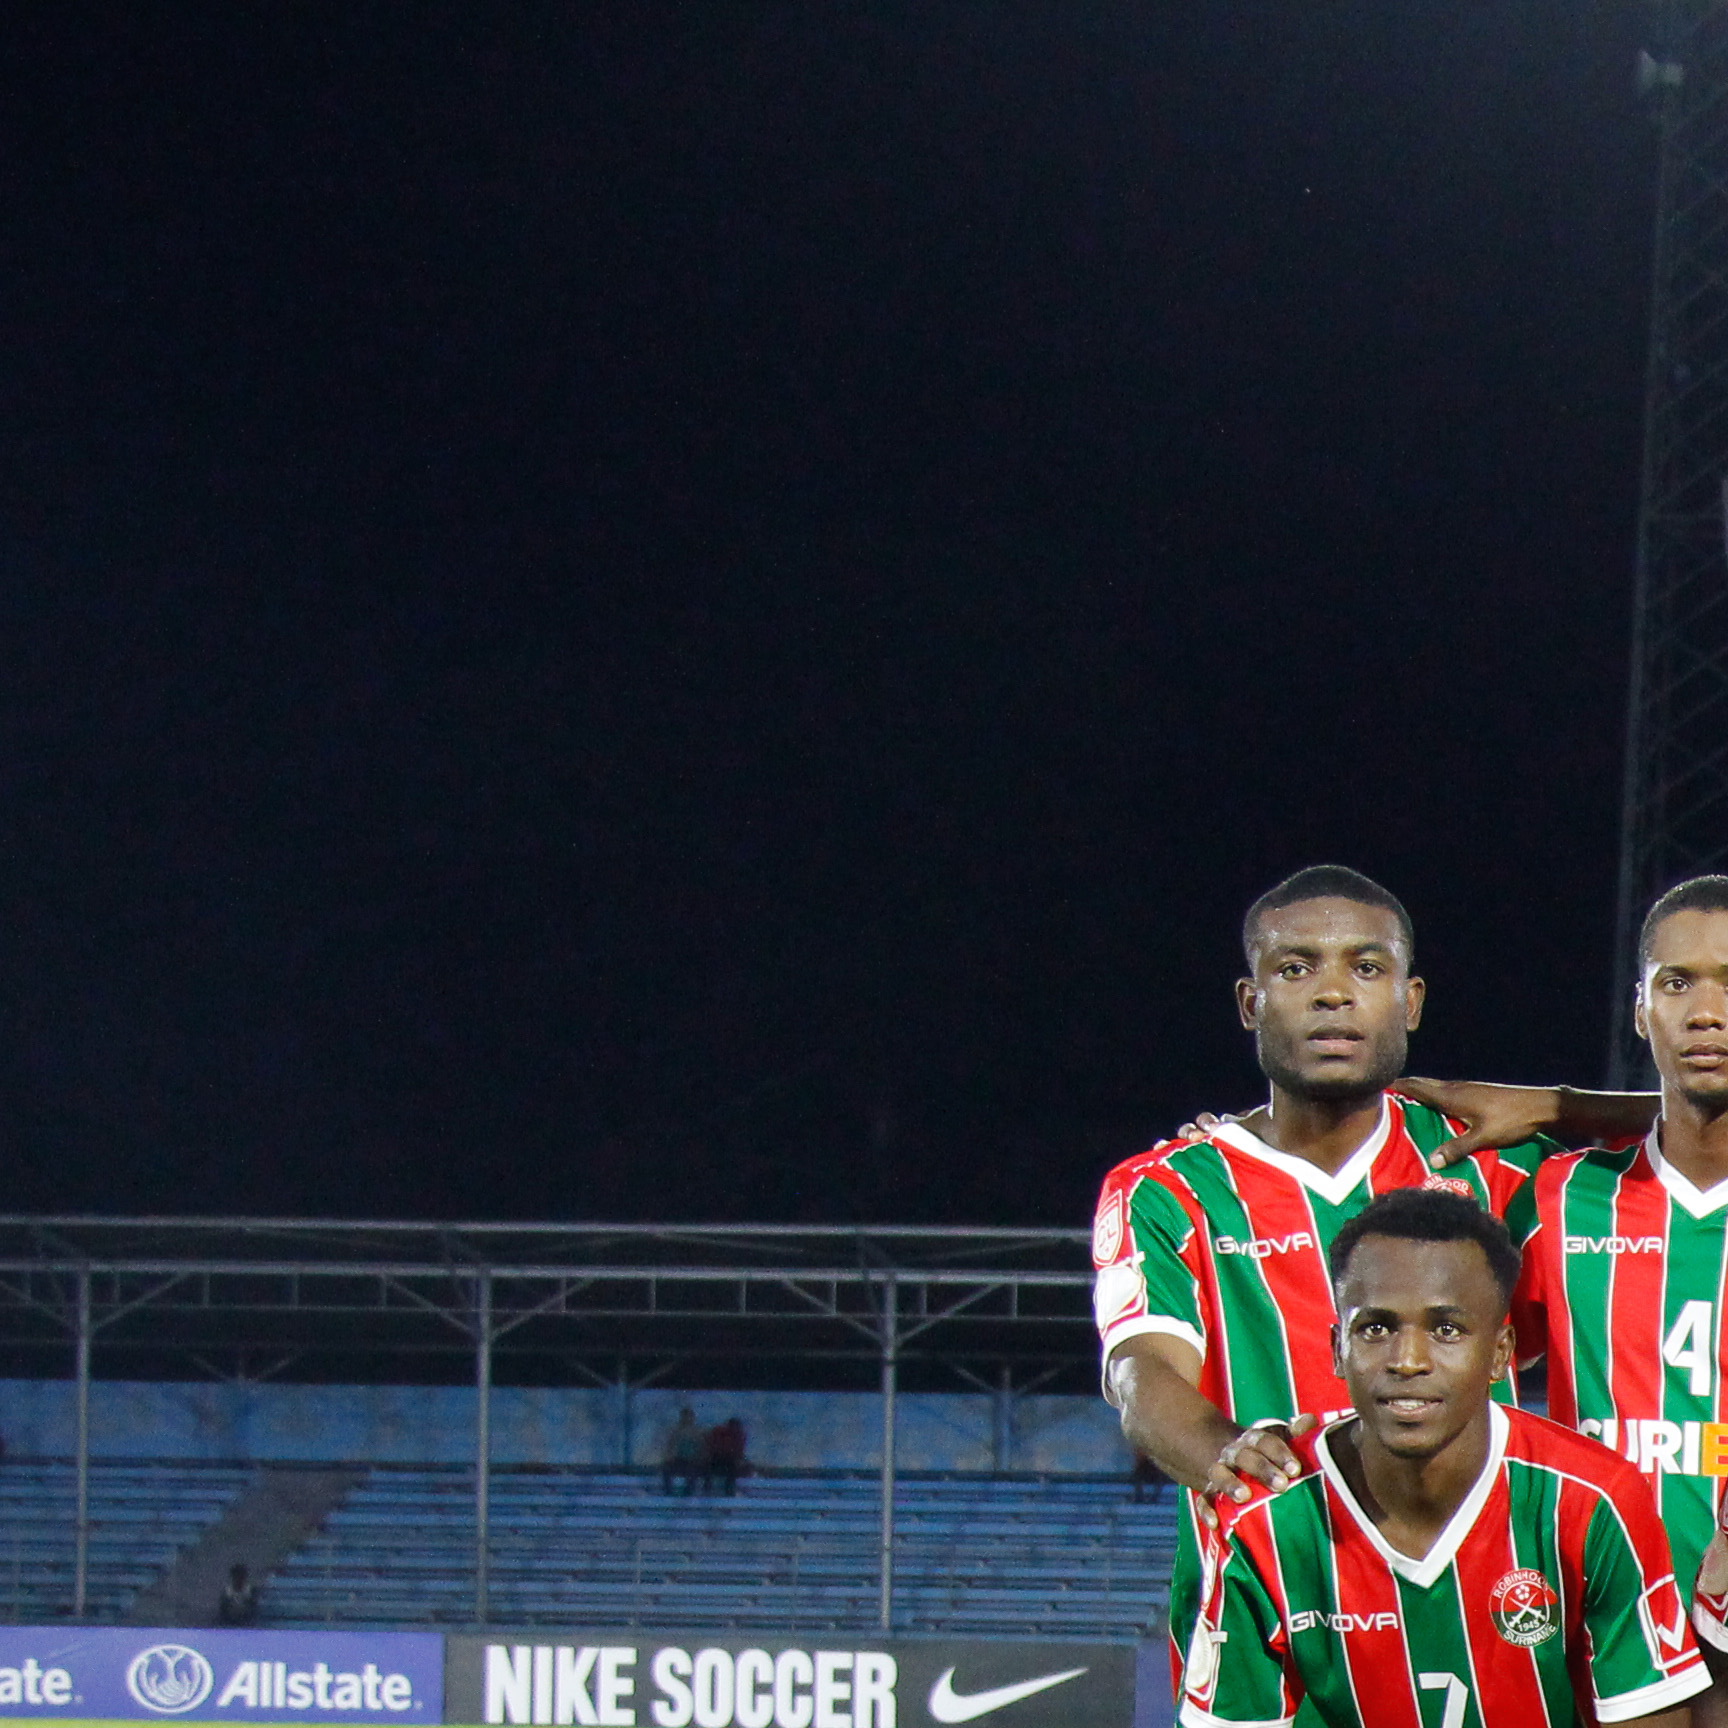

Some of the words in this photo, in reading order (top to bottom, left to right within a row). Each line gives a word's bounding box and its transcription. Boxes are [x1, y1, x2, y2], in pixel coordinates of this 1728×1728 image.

[1563, 1235, 1664, 1255] GIVOVA
[1662, 1299, 1714, 1397] 4
[1290, 1611, 1400, 1634] GIVOVA
[217, 1661, 414, 1710] Allstate
[485, 1645, 638, 1726] NIKE
